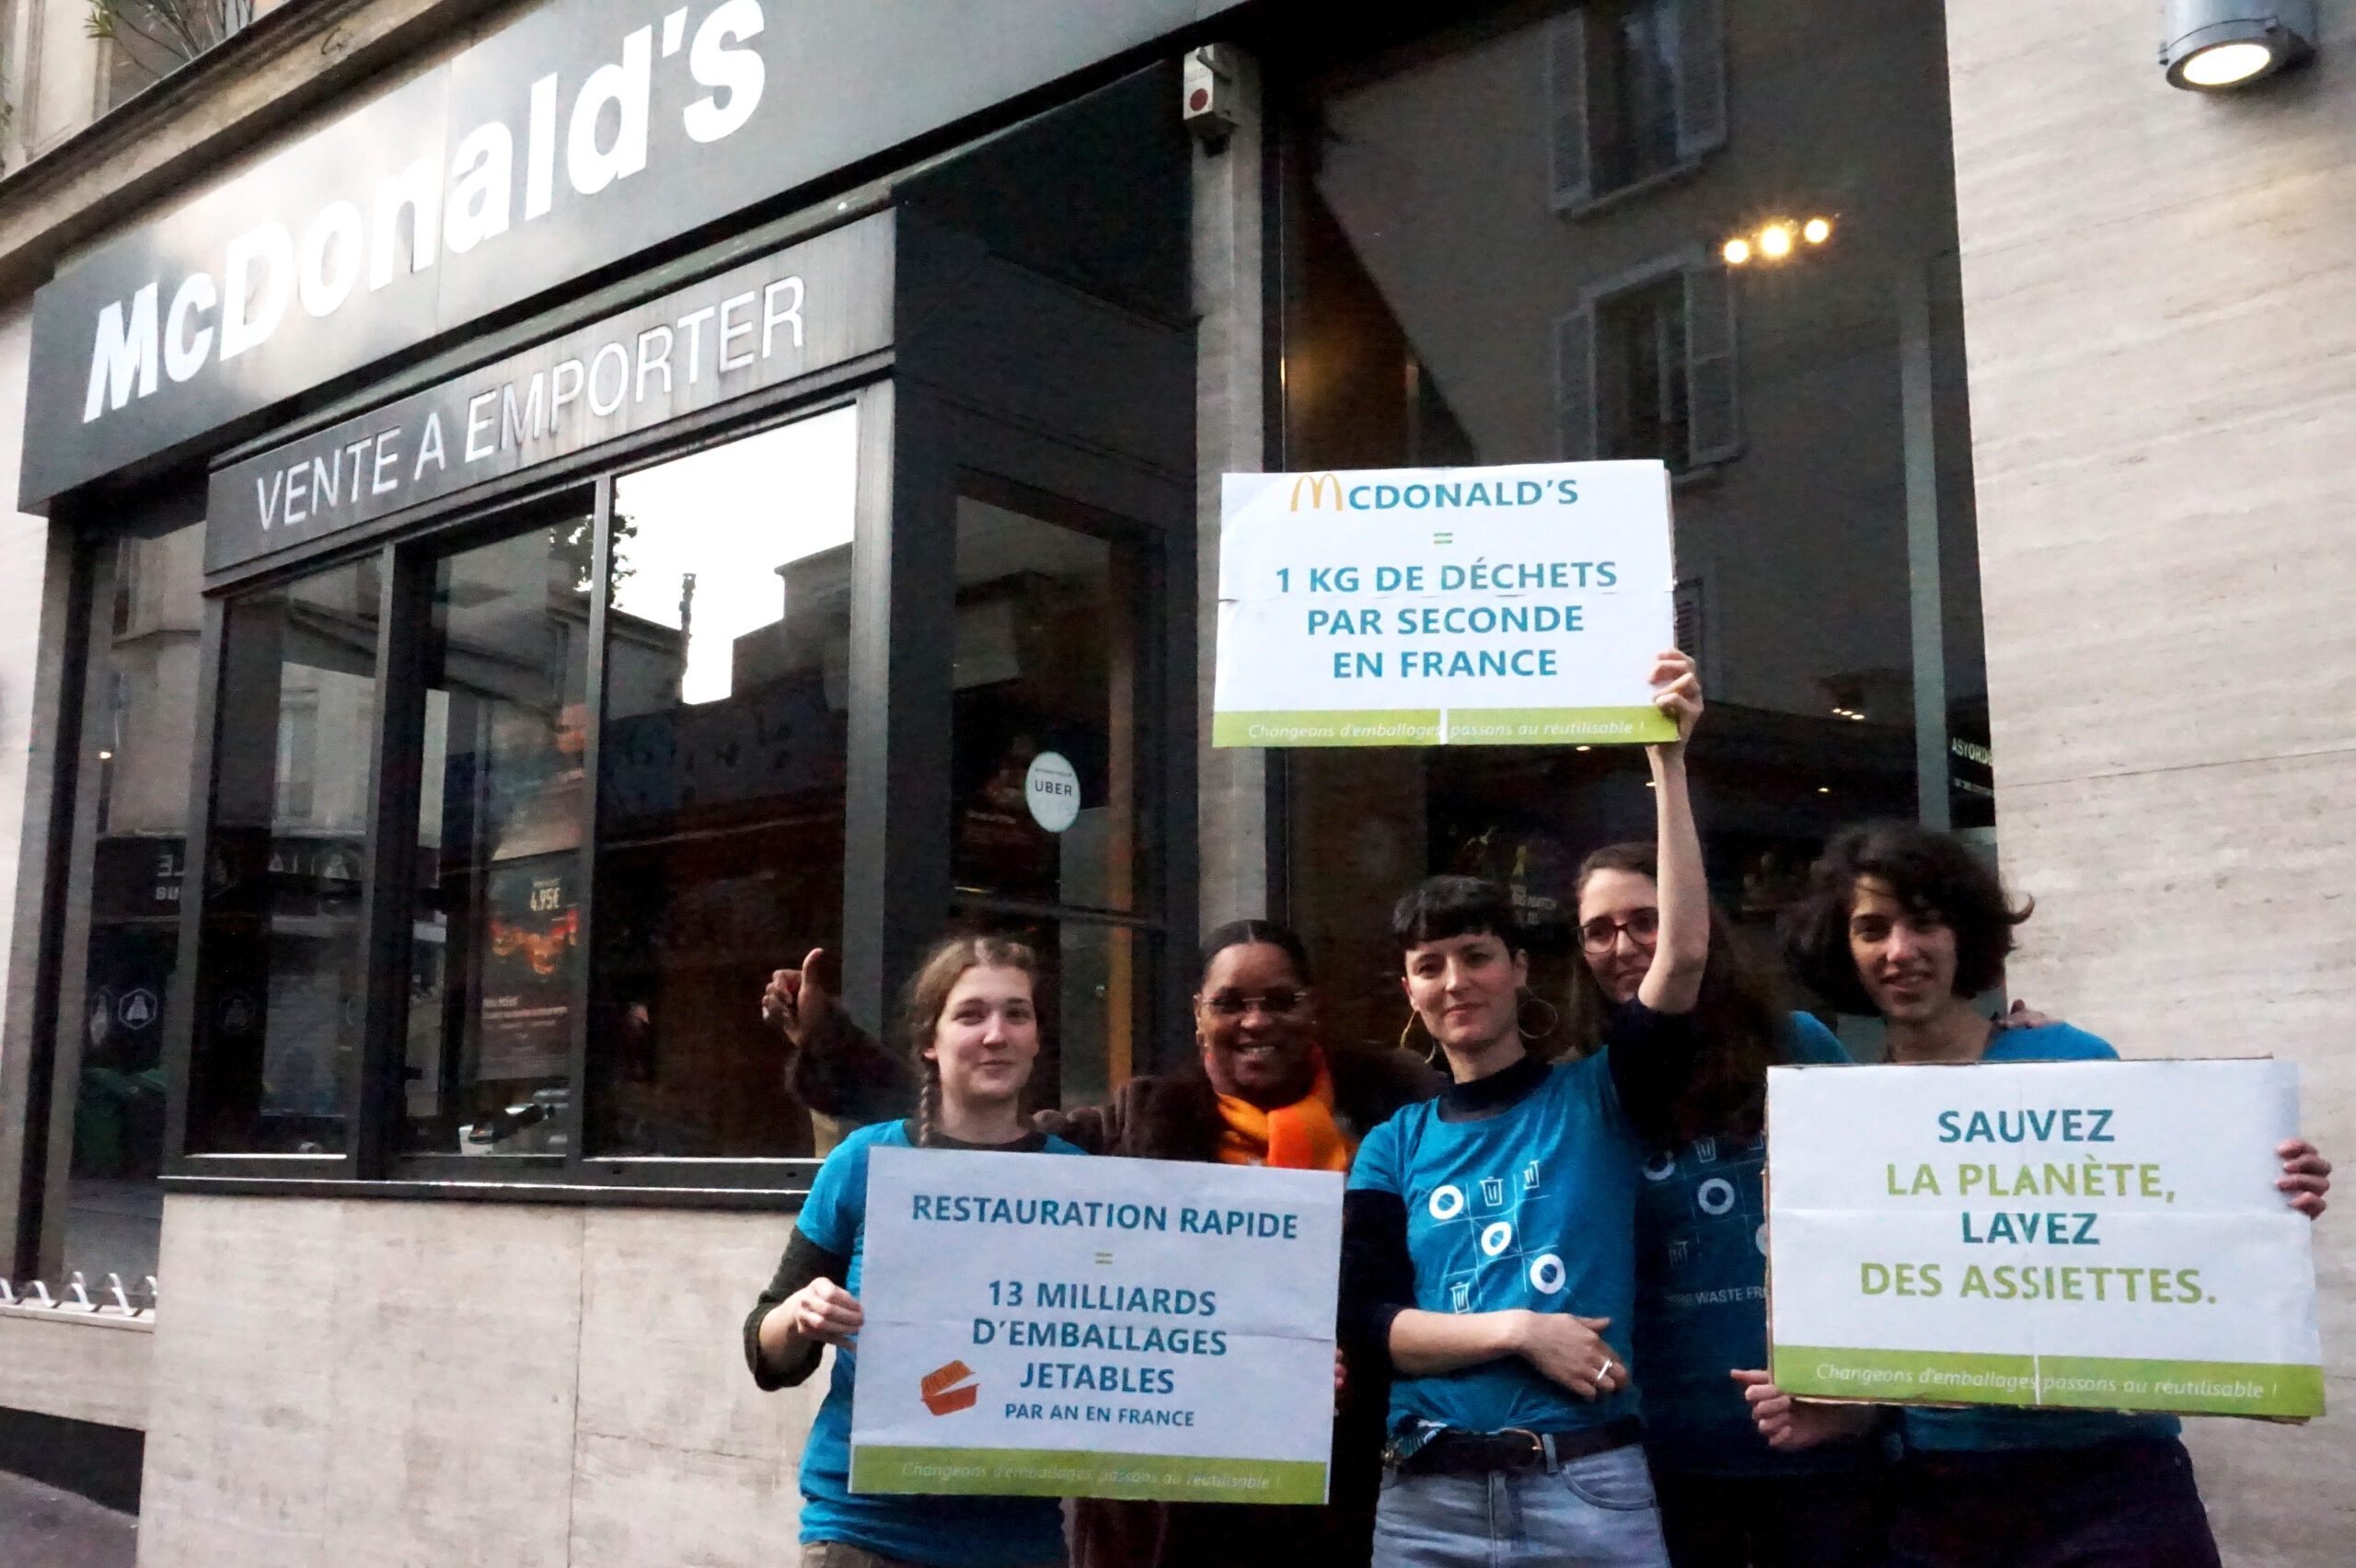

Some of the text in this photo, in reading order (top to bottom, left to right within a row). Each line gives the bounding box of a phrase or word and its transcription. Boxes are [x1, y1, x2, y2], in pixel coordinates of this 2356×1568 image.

[82, 0, 767, 424] McDonald's
[257, 275, 807, 531] VENTE A EMPORTER
[1276, 557, 1617, 594] 1 KG DE DÉCHETS
[1307, 605, 1584, 636] PAR SECONDE
[1333, 649, 1557, 679] EN FRANCE
[1248, 723, 1335, 740] Changeons
[1450, 724, 1513, 739] passons
[1519, 724, 1539, 736] au
[1034, 779, 1073, 797] UBER
[1937, 1108, 2116, 1143] SAUVEZ
[1886, 1153, 2176, 1204] LA PLANÈTE,
[912, 1194, 1299, 1239] RESTAURATION RAPIDE
[1961, 1211, 2101, 1246] LAVEZ
[988, 1280, 1217, 1317] 13 MILLIARDS
[1696, 1288, 1743, 1305] WASTE
[1860, 1262, 2218, 1305] DES ASSIETTES.
[972, 1319, 1227, 1356] D'EMBALLAGES
[1019, 1363, 1175, 1394] JETABLES
[1816, 1364, 1913, 1386] Changeons
[2042, 1376, 2117, 1393] passons
[2123, 1381, 2147, 1393] au
[2154, 1379, 2264, 1399] réutilisable
[1005, 1402, 1195, 1427] PAR AN EN FRANCE
[902, 1461, 987, 1481] Changeons
